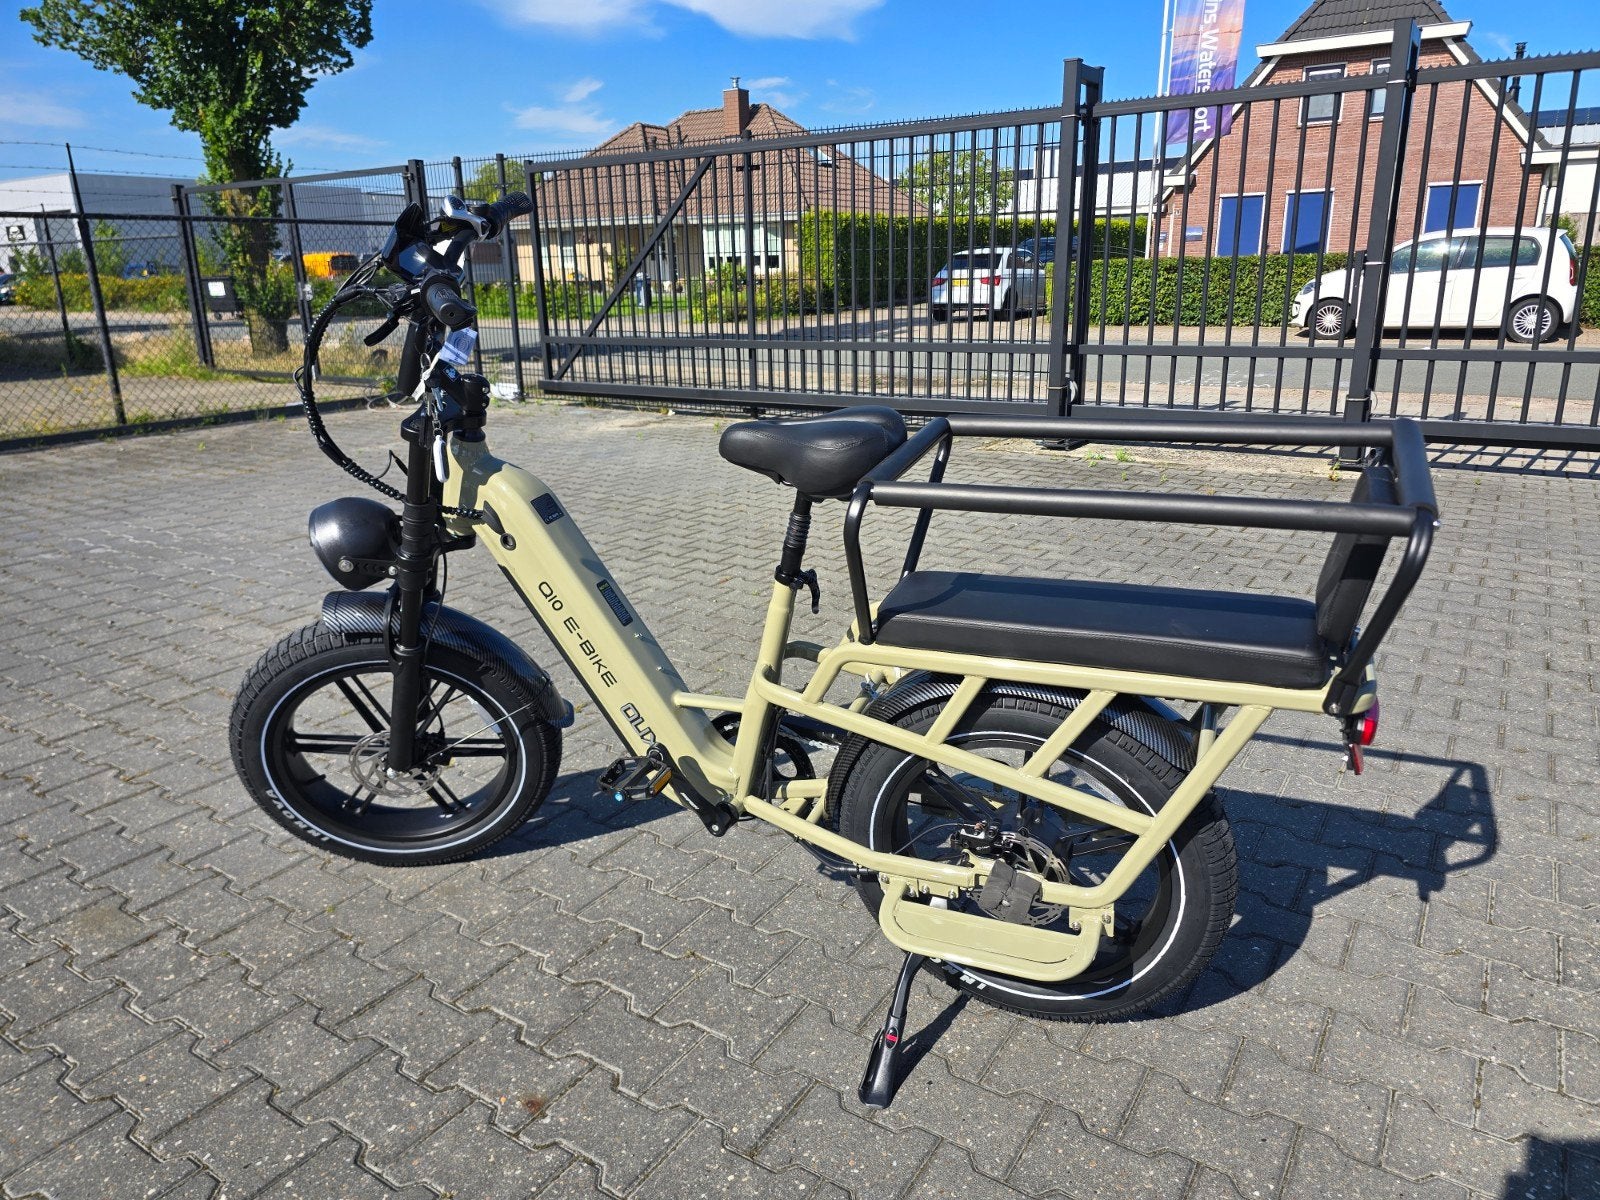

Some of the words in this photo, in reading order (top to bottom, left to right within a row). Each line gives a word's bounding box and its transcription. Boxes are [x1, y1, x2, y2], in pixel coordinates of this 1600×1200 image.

[1194, 28, 1220, 134] Watersort
[563, 616, 618, 688] E-BIKE
[265, 788, 331, 841] INNOVA
